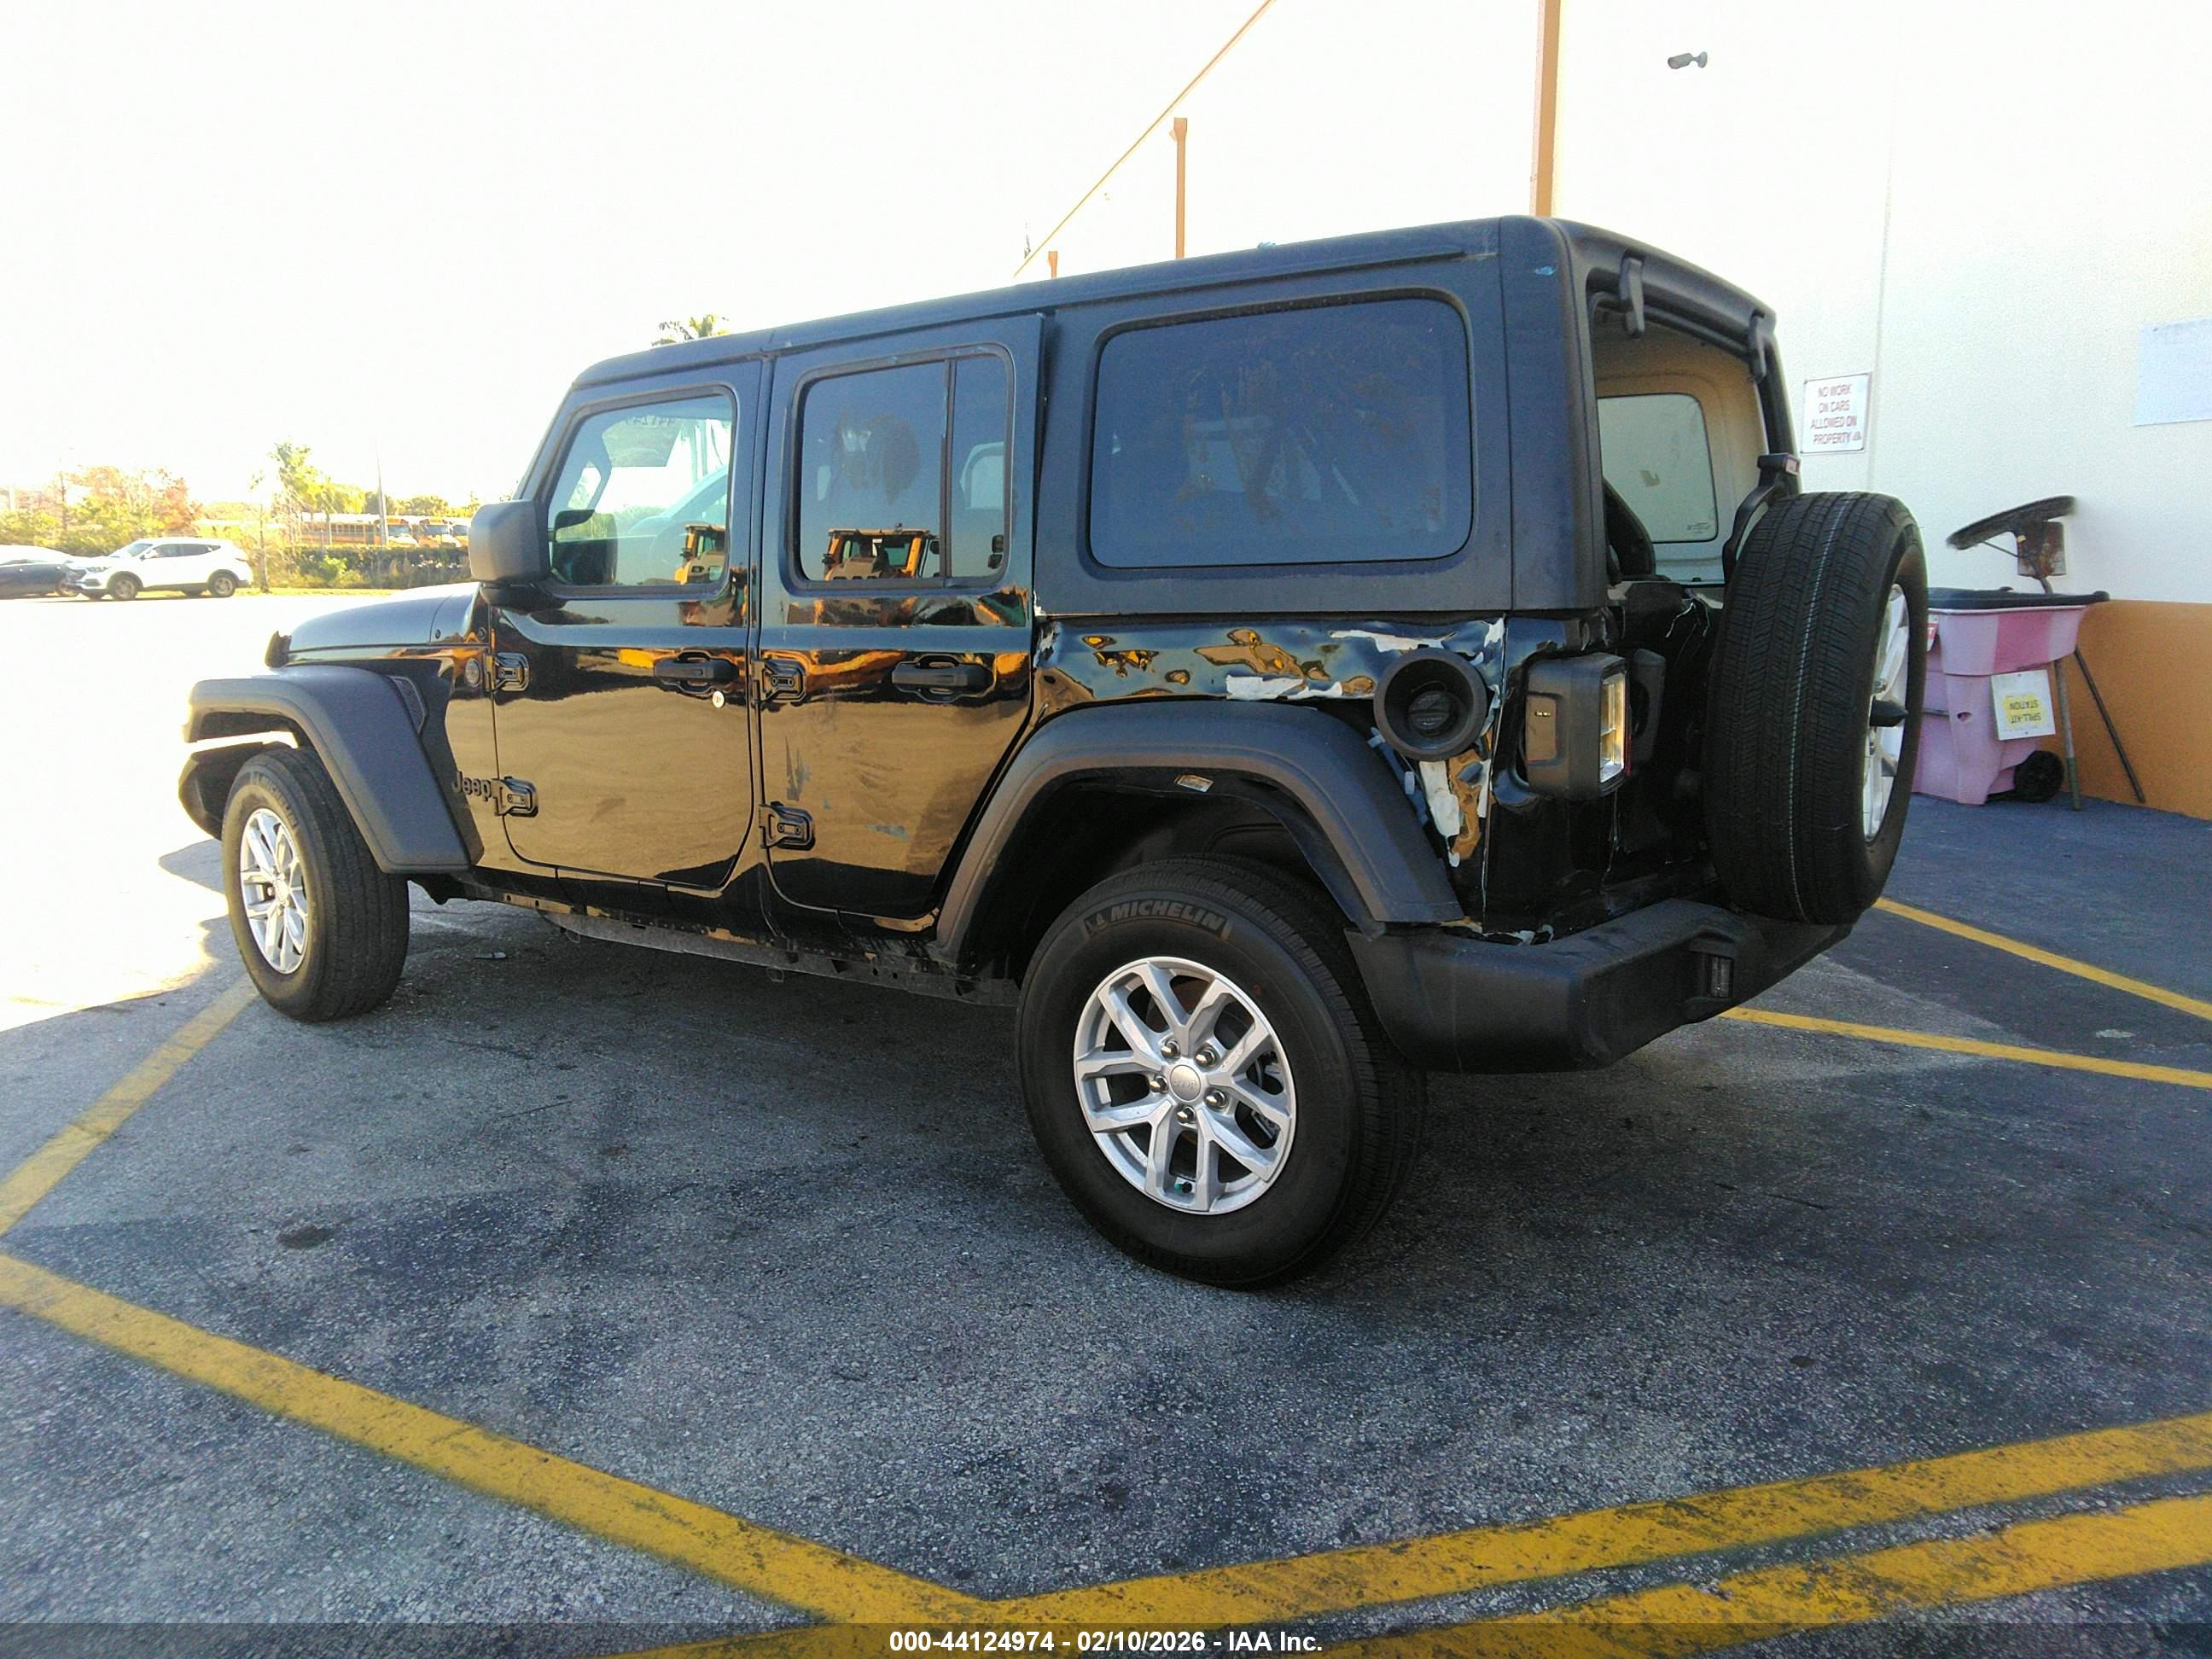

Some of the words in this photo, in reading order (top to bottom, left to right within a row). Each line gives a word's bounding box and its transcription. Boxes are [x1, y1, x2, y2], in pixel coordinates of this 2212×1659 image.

[1818, 387, 1829, 398] NO
[1830, 384, 1852, 396] WORK
[1818, 402, 1829, 414] ON
[1831, 399, 1850, 413] CARS
[1810, 416, 1844, 429] ALLOWED
[1846, 415, 1857, 428] ON
[1813, 432, 1852, 445] PROPERTY
[451, 770, 492, 802] Jeep
[1110, 899, 1227, 932] MICHELIN
